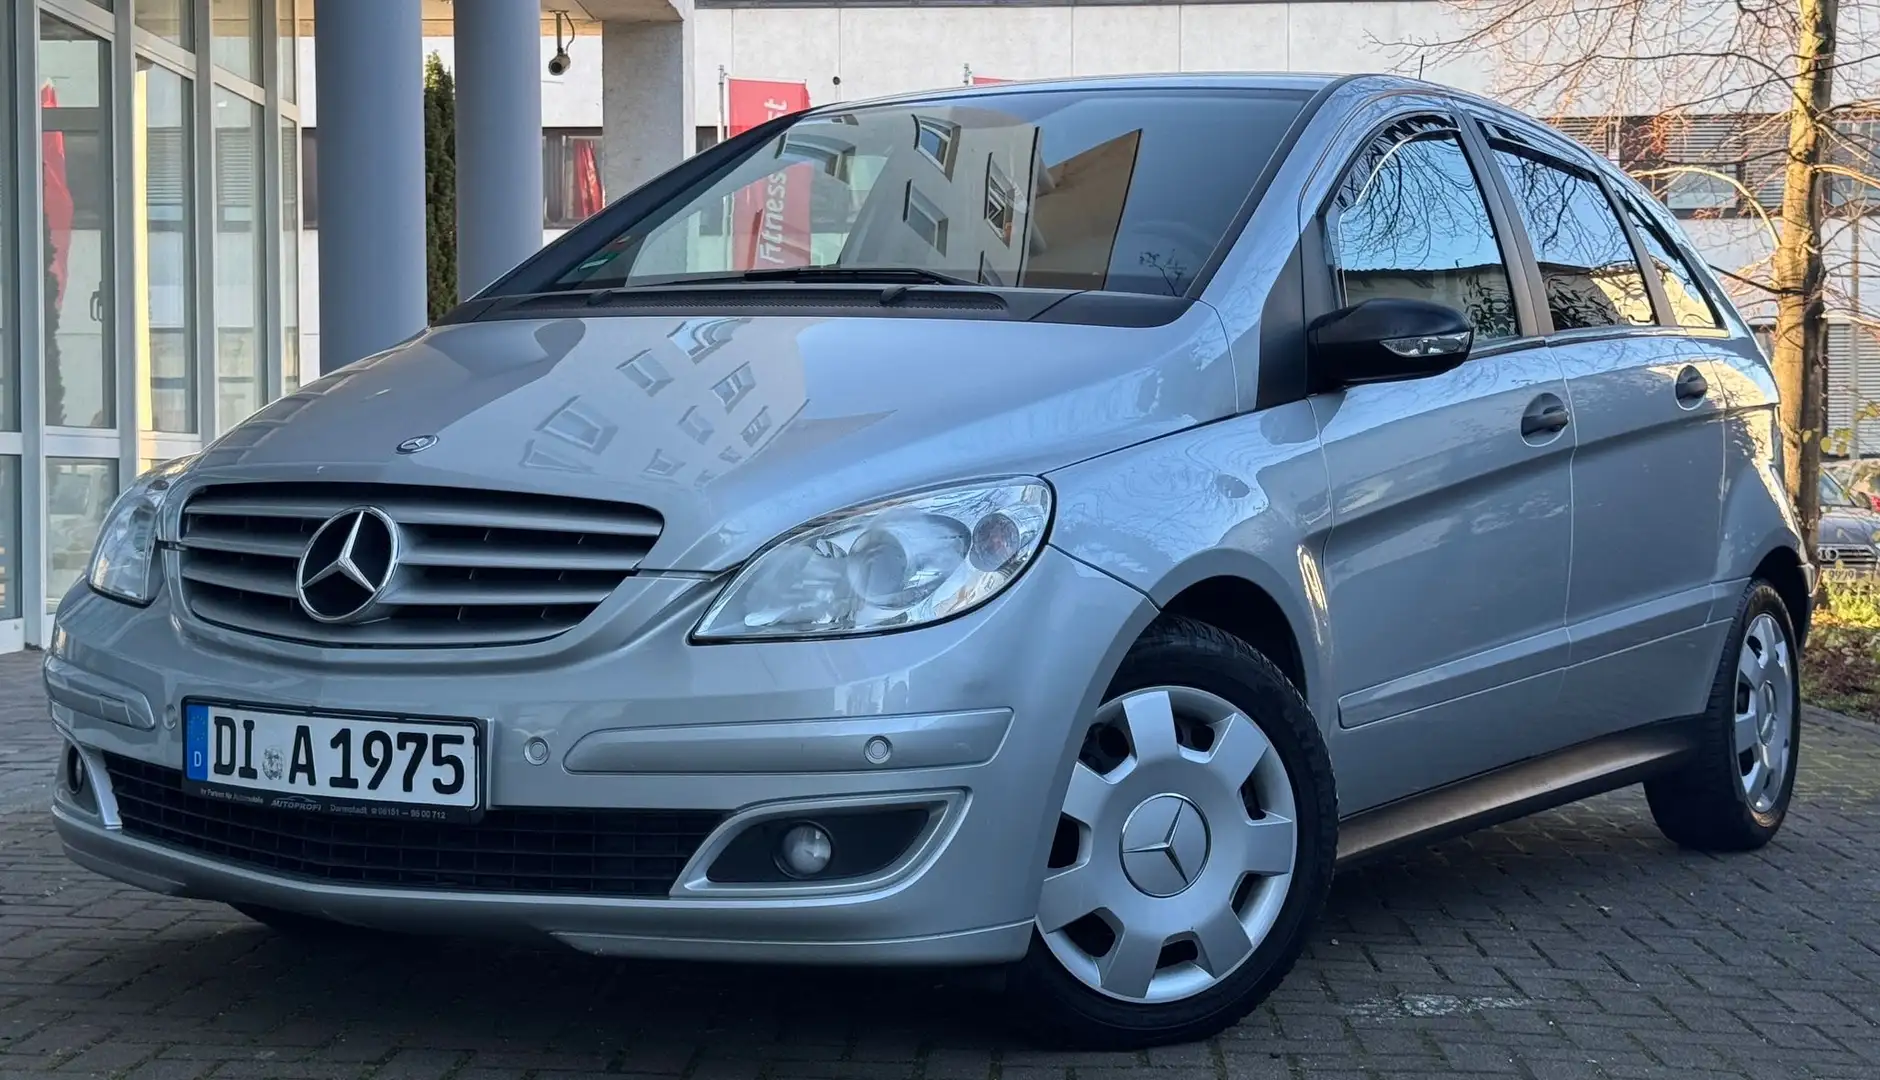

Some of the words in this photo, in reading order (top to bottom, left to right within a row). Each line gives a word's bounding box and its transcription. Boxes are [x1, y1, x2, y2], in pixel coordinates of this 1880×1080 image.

[760, 171, 787, 264] Fitness
[194, 751, 202, 767] D
[213, 715, 258, 780] DI
[288, 724, 317, 787] A
[329, 727, 465, 795] 1975
[271, 800, 322, 812] AUTOPROFI
